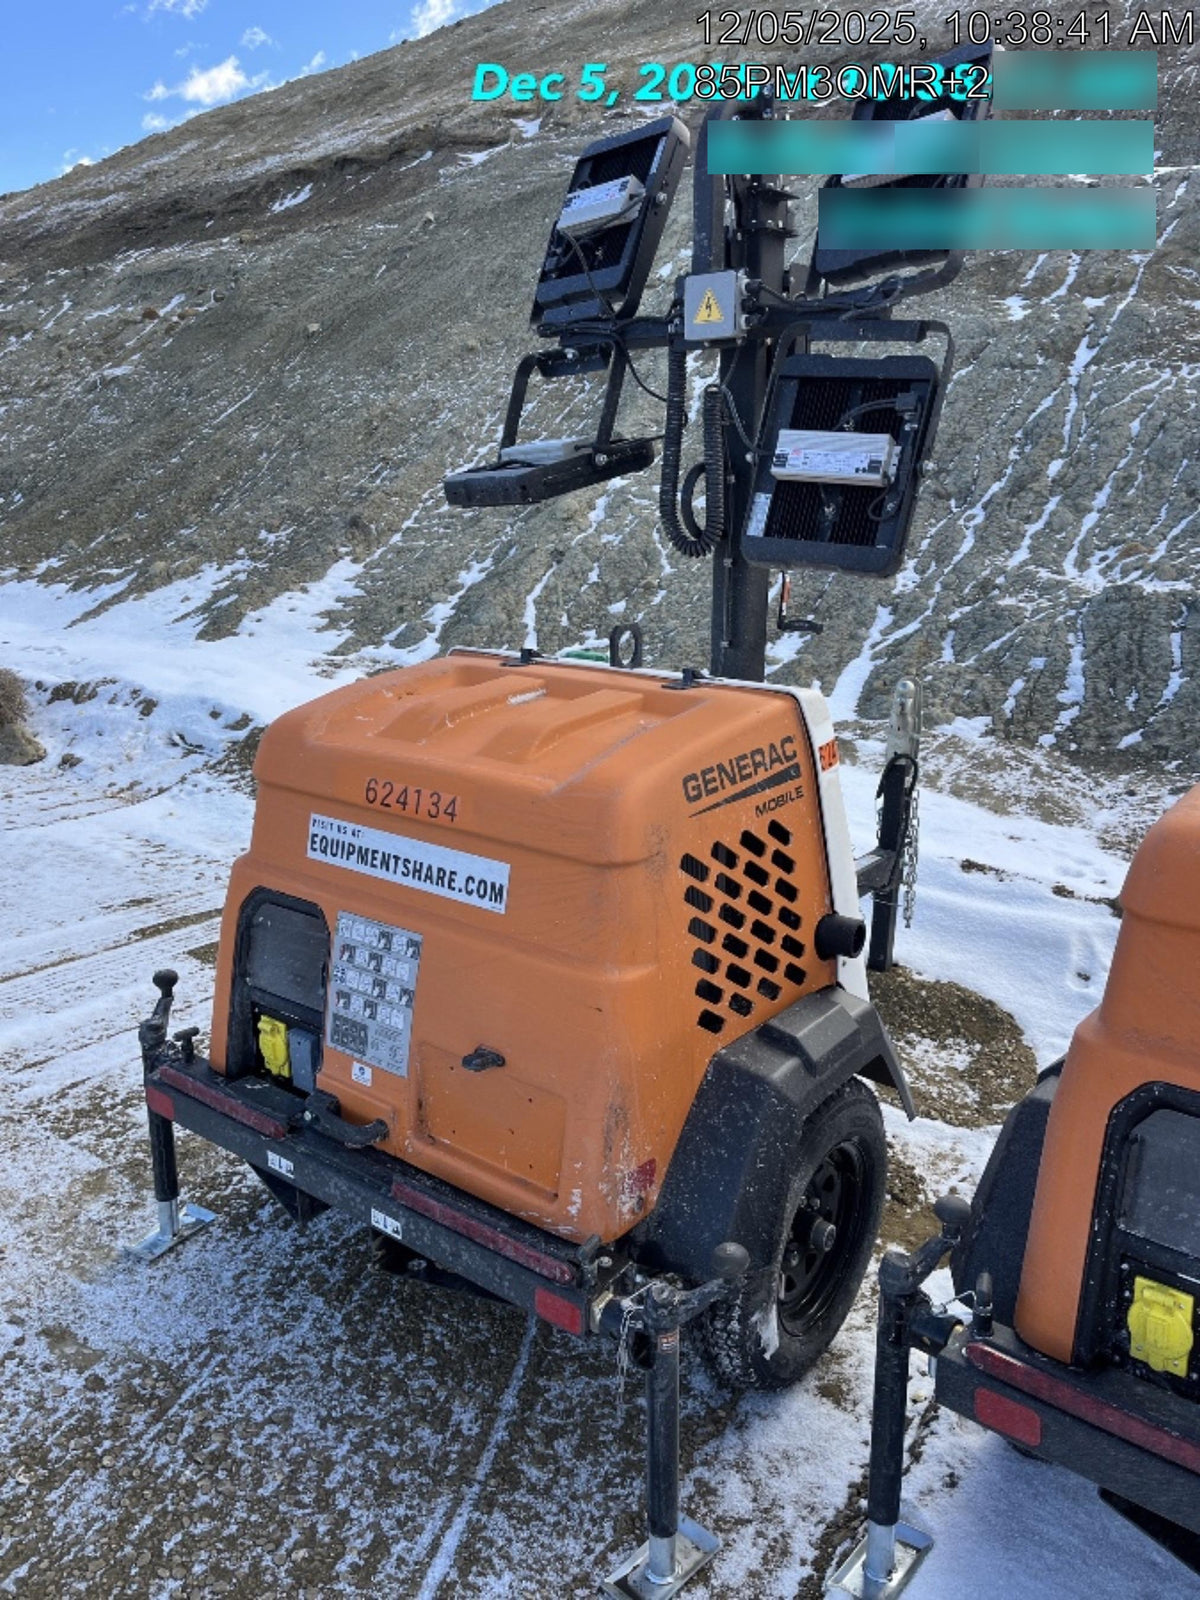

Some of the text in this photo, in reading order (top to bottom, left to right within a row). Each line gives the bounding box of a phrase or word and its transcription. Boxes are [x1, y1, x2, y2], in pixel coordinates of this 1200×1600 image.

[682, 736, 798, 804] GENERAC
[364, 778, 457, 823] 624134
[755, 786, 805, 818] MOBILE
[310, 832, 505, 905] EQUIPMENTSHARE.COM
